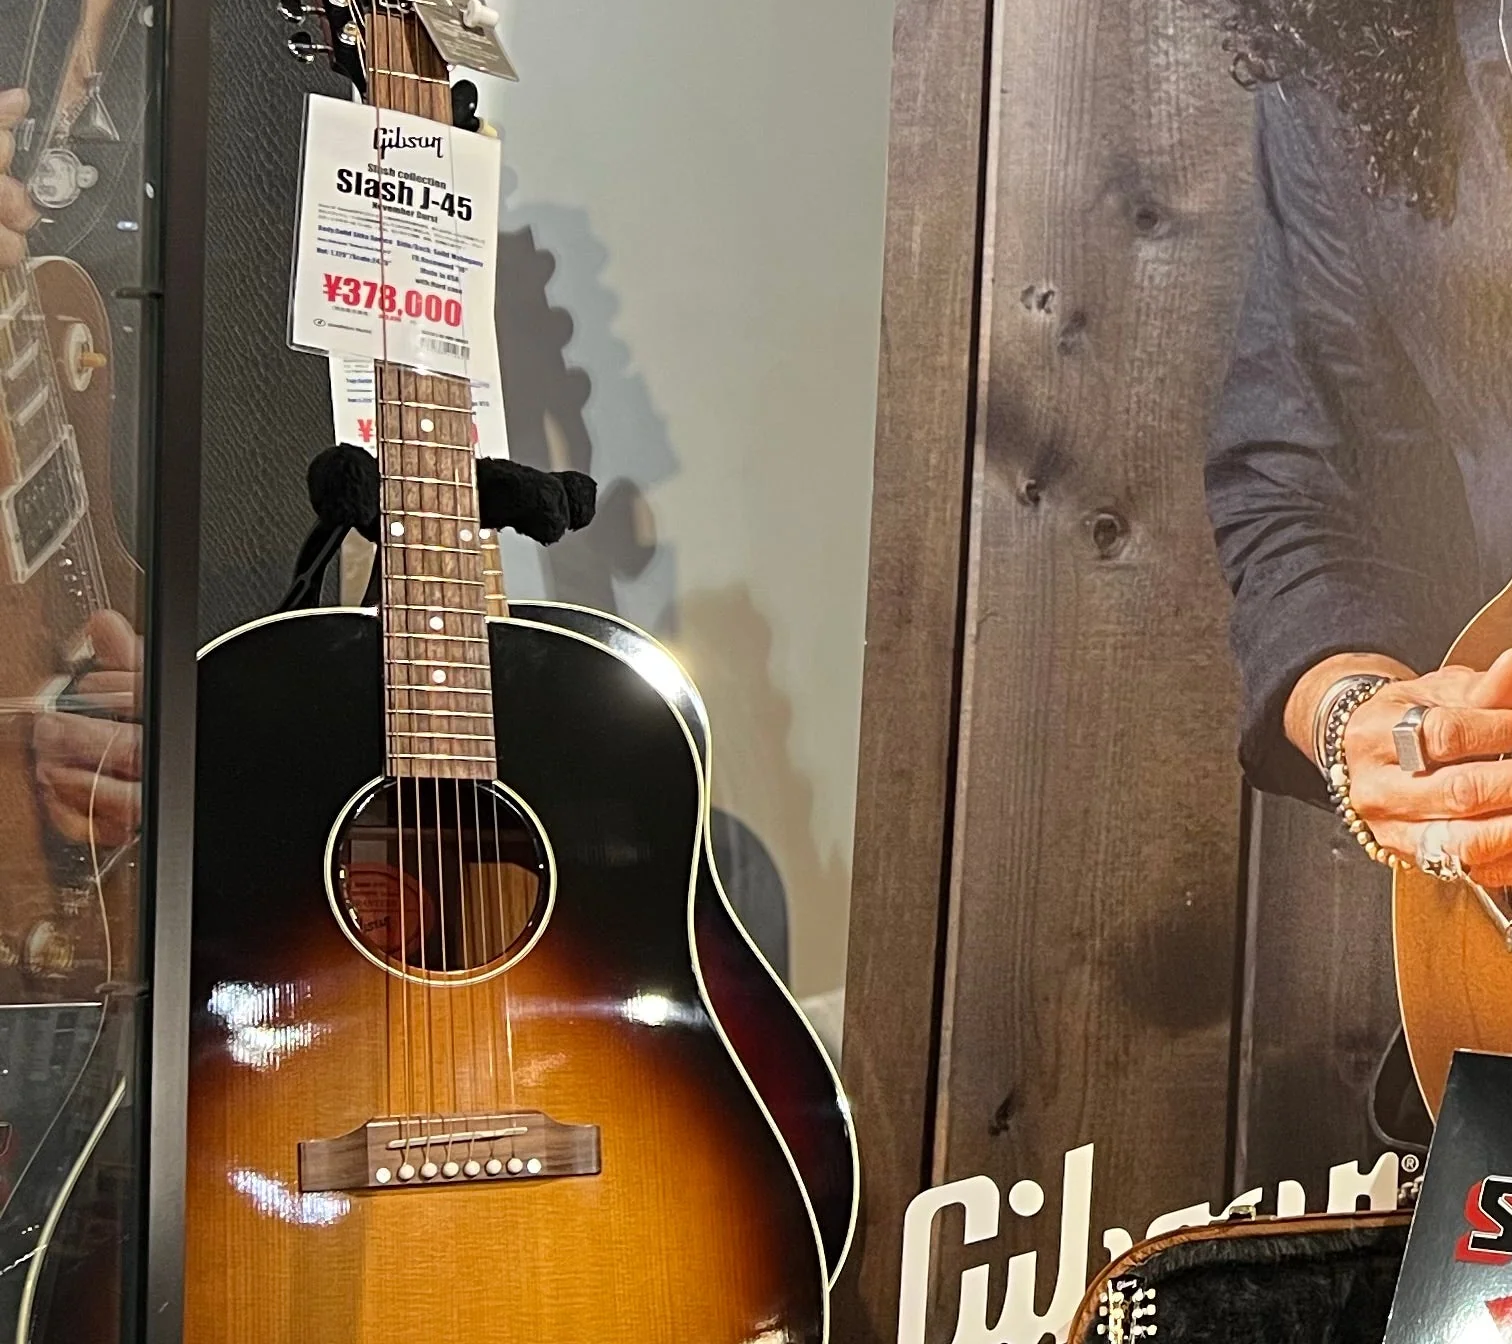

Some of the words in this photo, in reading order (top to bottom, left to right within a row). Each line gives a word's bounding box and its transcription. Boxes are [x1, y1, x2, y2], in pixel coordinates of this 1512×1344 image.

[373, 127, 444, 160] Gibson
[337, 168, 413, 207] Slash
[420, 186, 473, 222] J-45
[323, 273, 462, 328] ¥378,000
